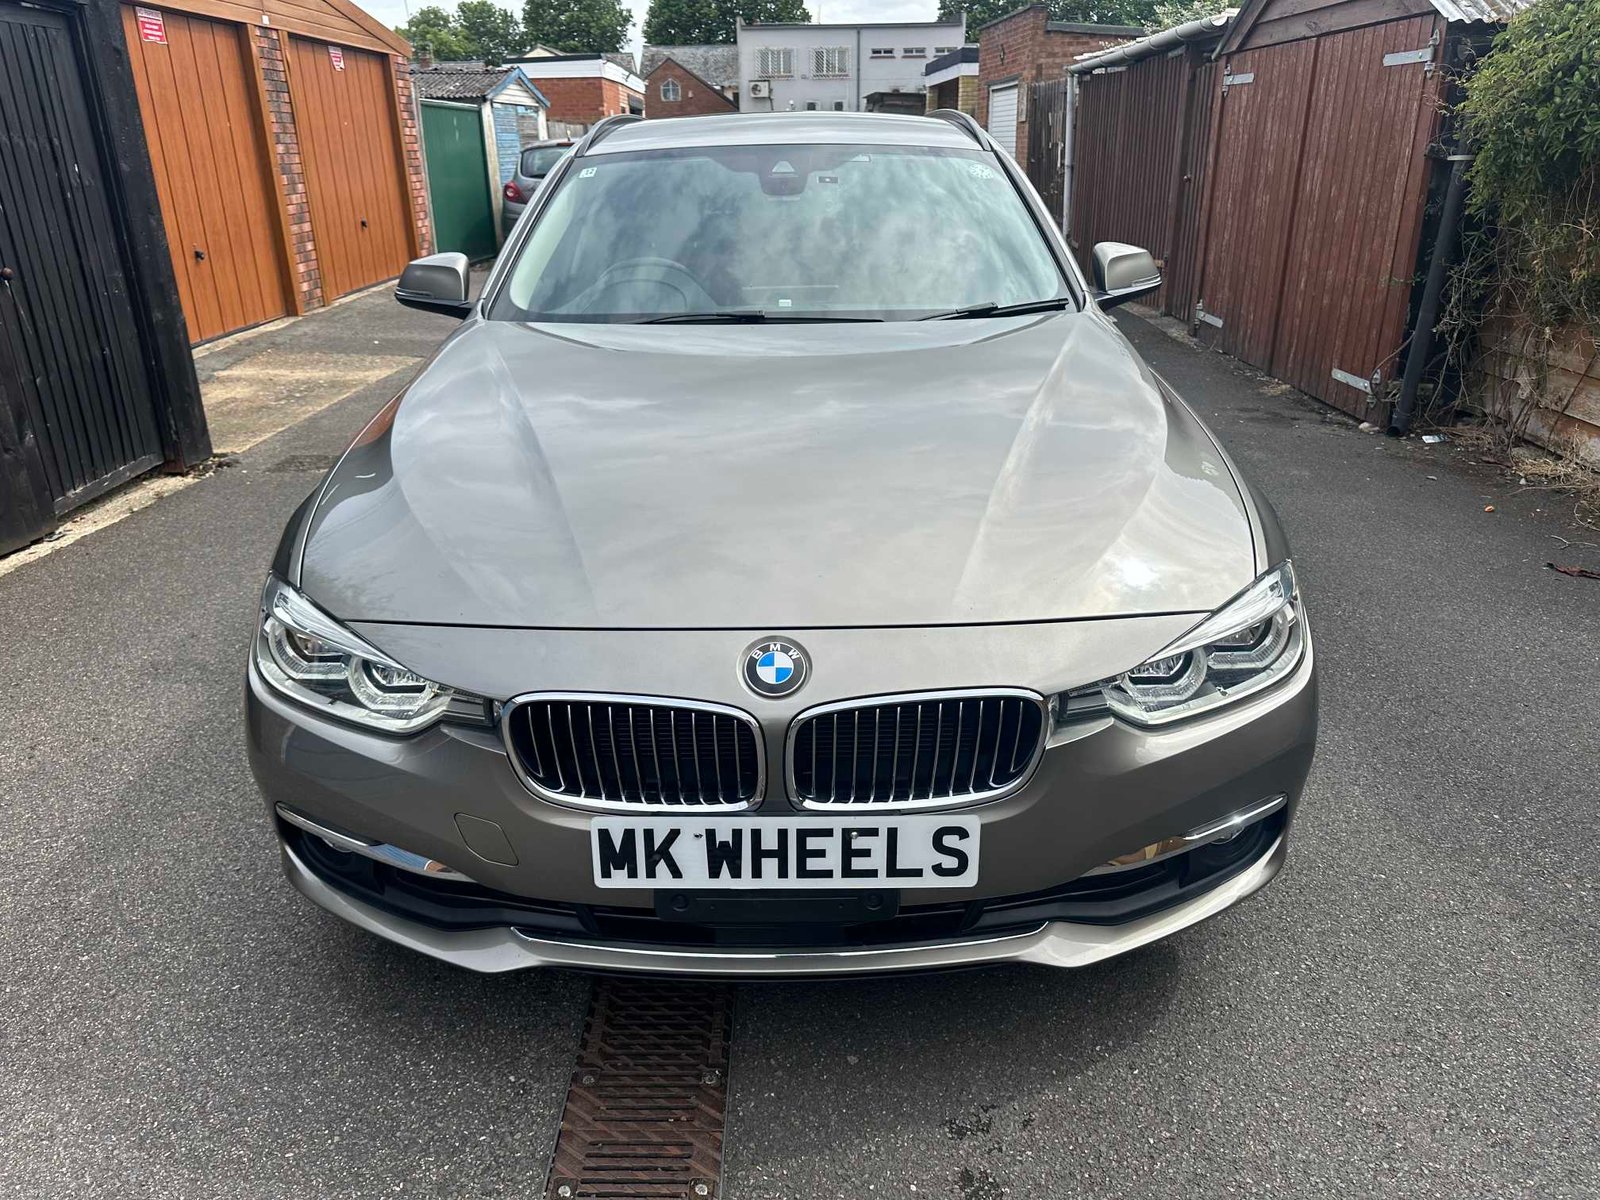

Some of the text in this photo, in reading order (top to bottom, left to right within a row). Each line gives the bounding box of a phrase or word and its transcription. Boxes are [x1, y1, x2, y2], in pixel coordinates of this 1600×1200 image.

[751, 643, 800, 660] BMW
[597, 826, 970, 879] MK WHEELS
